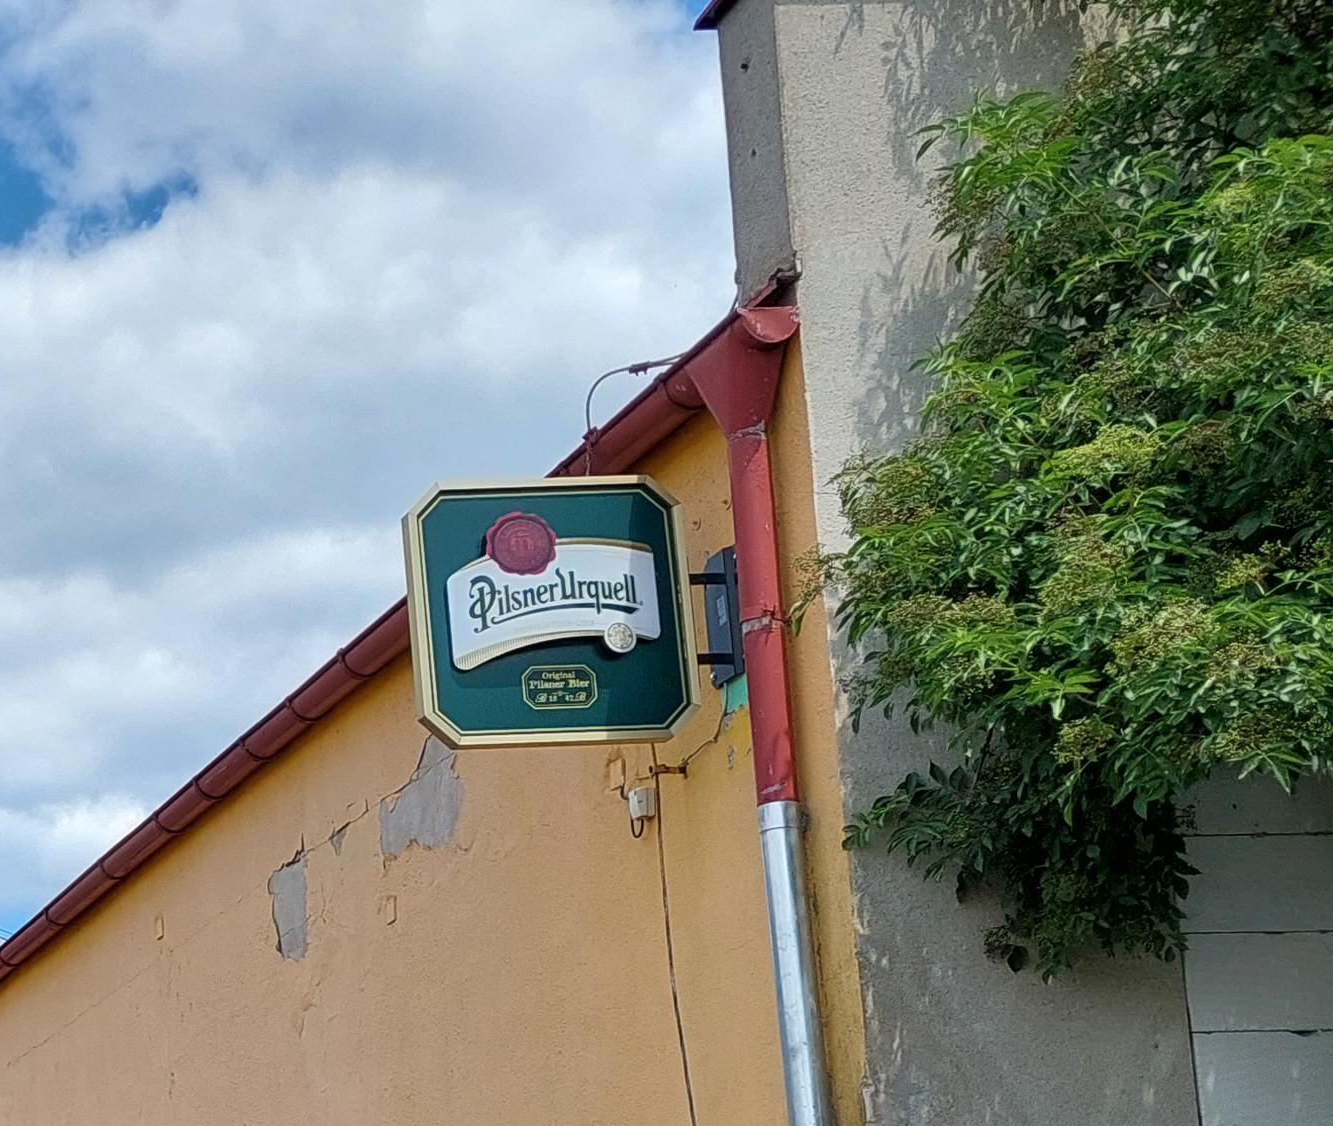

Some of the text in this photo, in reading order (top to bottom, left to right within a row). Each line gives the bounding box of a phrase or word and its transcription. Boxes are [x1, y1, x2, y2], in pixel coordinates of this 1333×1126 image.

[468, 567, 638, 634] Pilsner Urquell
[541, 671, 576, 680] Original
[568, 679, 590, 688] Bier
